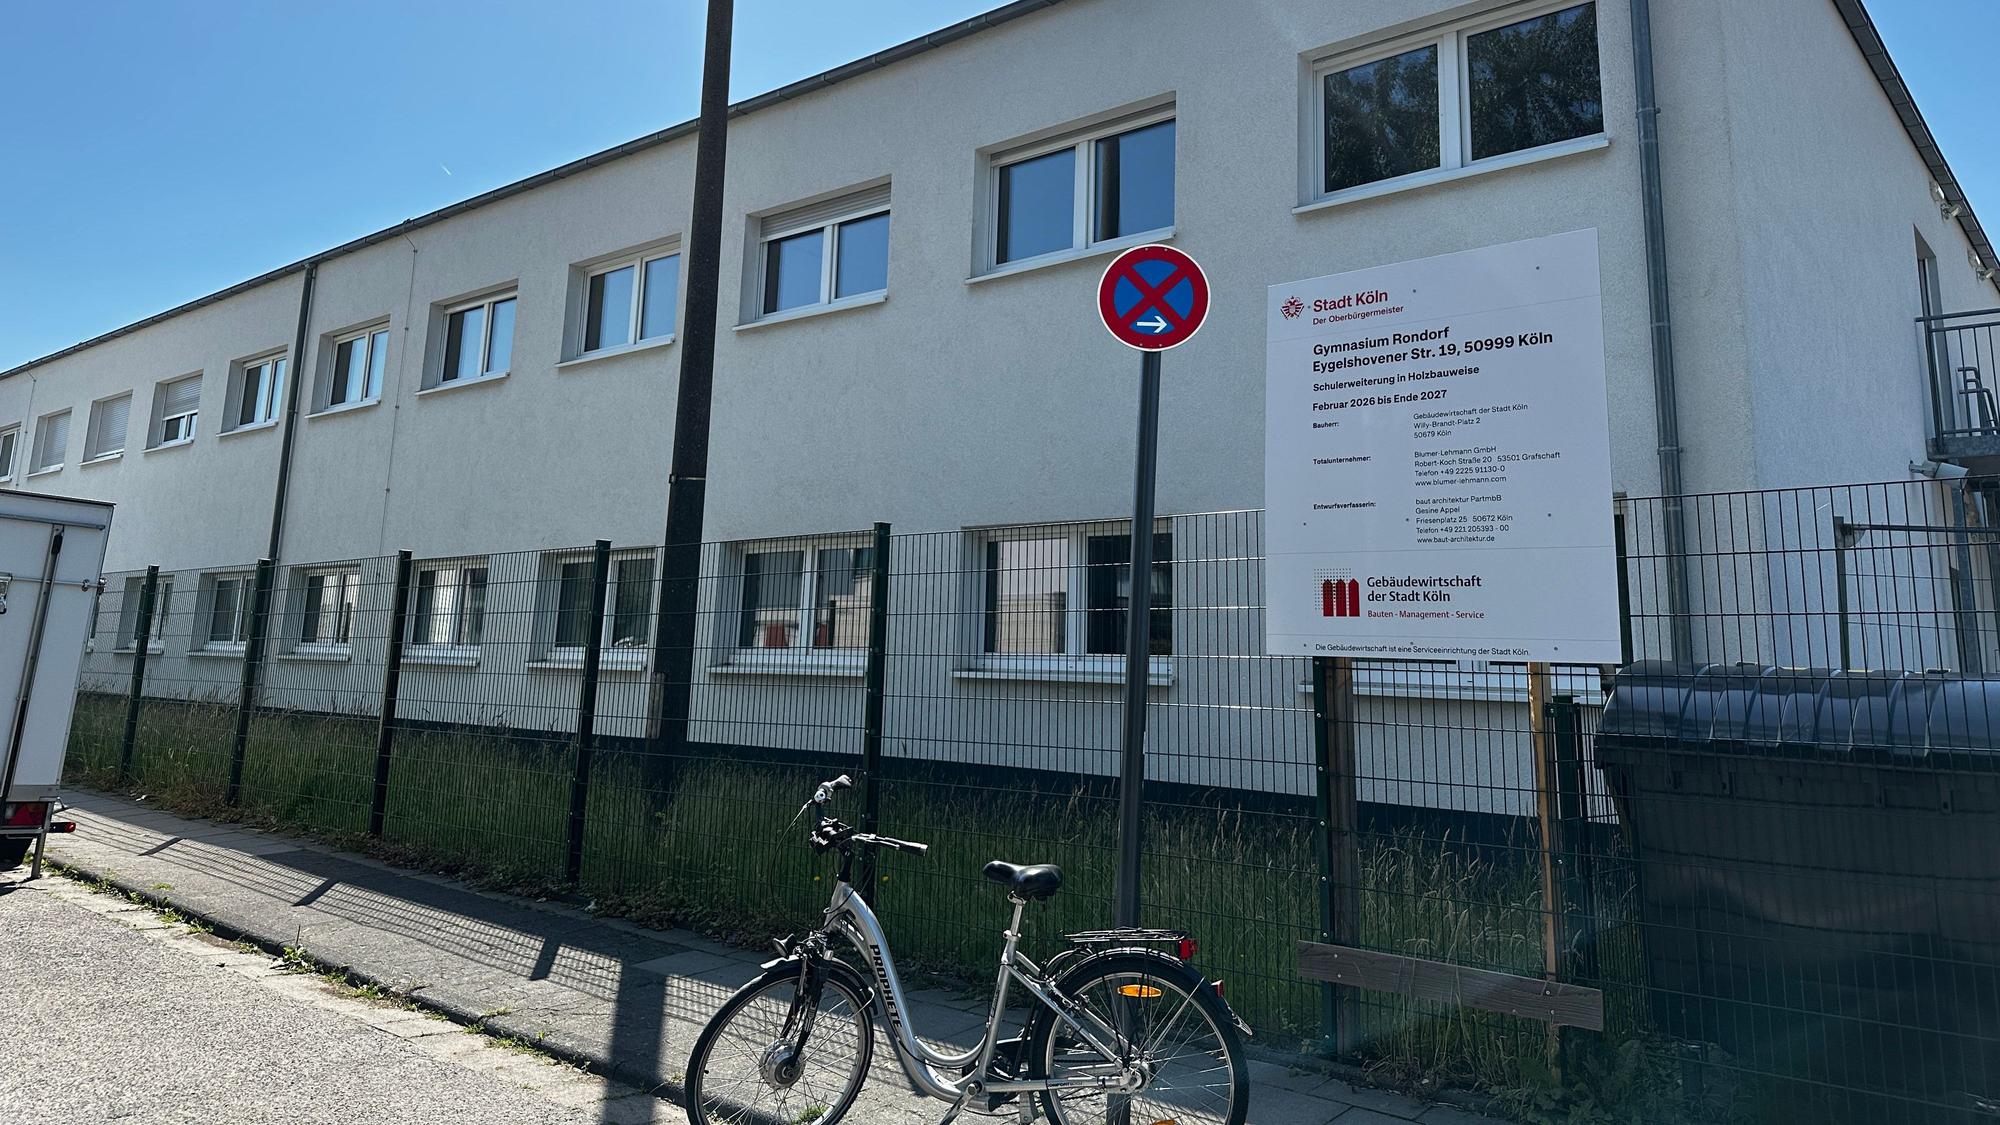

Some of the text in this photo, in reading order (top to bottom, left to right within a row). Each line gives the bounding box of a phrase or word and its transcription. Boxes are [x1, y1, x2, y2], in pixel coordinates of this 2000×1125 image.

[1313, 290, 1388, 312] Stadt Köln
[1312, 306, 1404, 325] Der Oberbürgermeister
[1313, 326, 1450, 356] Gymnasium Rondorf
[1312, 331, 1553, 373] Eygelshovener Str. 19, 50999 Köln
[1312, 365, 1480, 392] Schulerweiterung in Holzbauweise
[1312, 389, 1448, 411] Februar 2026 bis Ende 2027
[1413, 403, 1528, 420] Gebäudewirtschaft der Stadt Köln
[1312, 421, 1340, 429] Bauherr:
[1413, 418, 1475, 429] Willy-Brandt-Platz
[1413, 429, 1452, 439] 50679 Köln
[1414, 445, 1497, 458] Blumer-Lehmann GmbH
[1313, 456, 1372, 465] Totalunternehmer:
[1414, 451, 1561, 468] Robert-Koch Straße 20 53501 Grafschaft
[1414, 469, 1439, 477] Telefon
[1440, 468, 1455, 476] +49
[1455, 466, 1474, 475] 2225
[1414, 475, 1507, 487] www.blumer-lehmann.com
[1313, 501, 1377, 510] Entwurfsverfasserin:
[1415, 495, 1502, 506] baut architektur PartmbB
[1415, 506, 1461, 515] Gesine Appel
[1415, 517, 1457, 525] Friesenplatz
[1472, 515, 1496, 523] 50672
[1497, 514, 1513, 522] Köln
[1416, 527, 1439, 535] Telefon
[1440, 526, 1454, 534] +49
[1416, 535, 1496, 544] www.baut-architektur.de
[1366, 575, 1483, 588] Gebäudewirtschaft
[1367, 590, 1451, 602] der Stadt Köln
[1367, 610, 1394, 618] Bauten
[1399, 610, 1450, 620] Management
[1455, 611, 1485, 619] Service
[1315, 643, 1327, 651] Die
[1327, 644, 1388, 652] Gebäudewirtschaft
[1412, 647, 1478, 656] Serviceeinrichtung
[1491, 648, 1512, 656] Stadt
[869, 944, 903, 1028] PROPHETE
